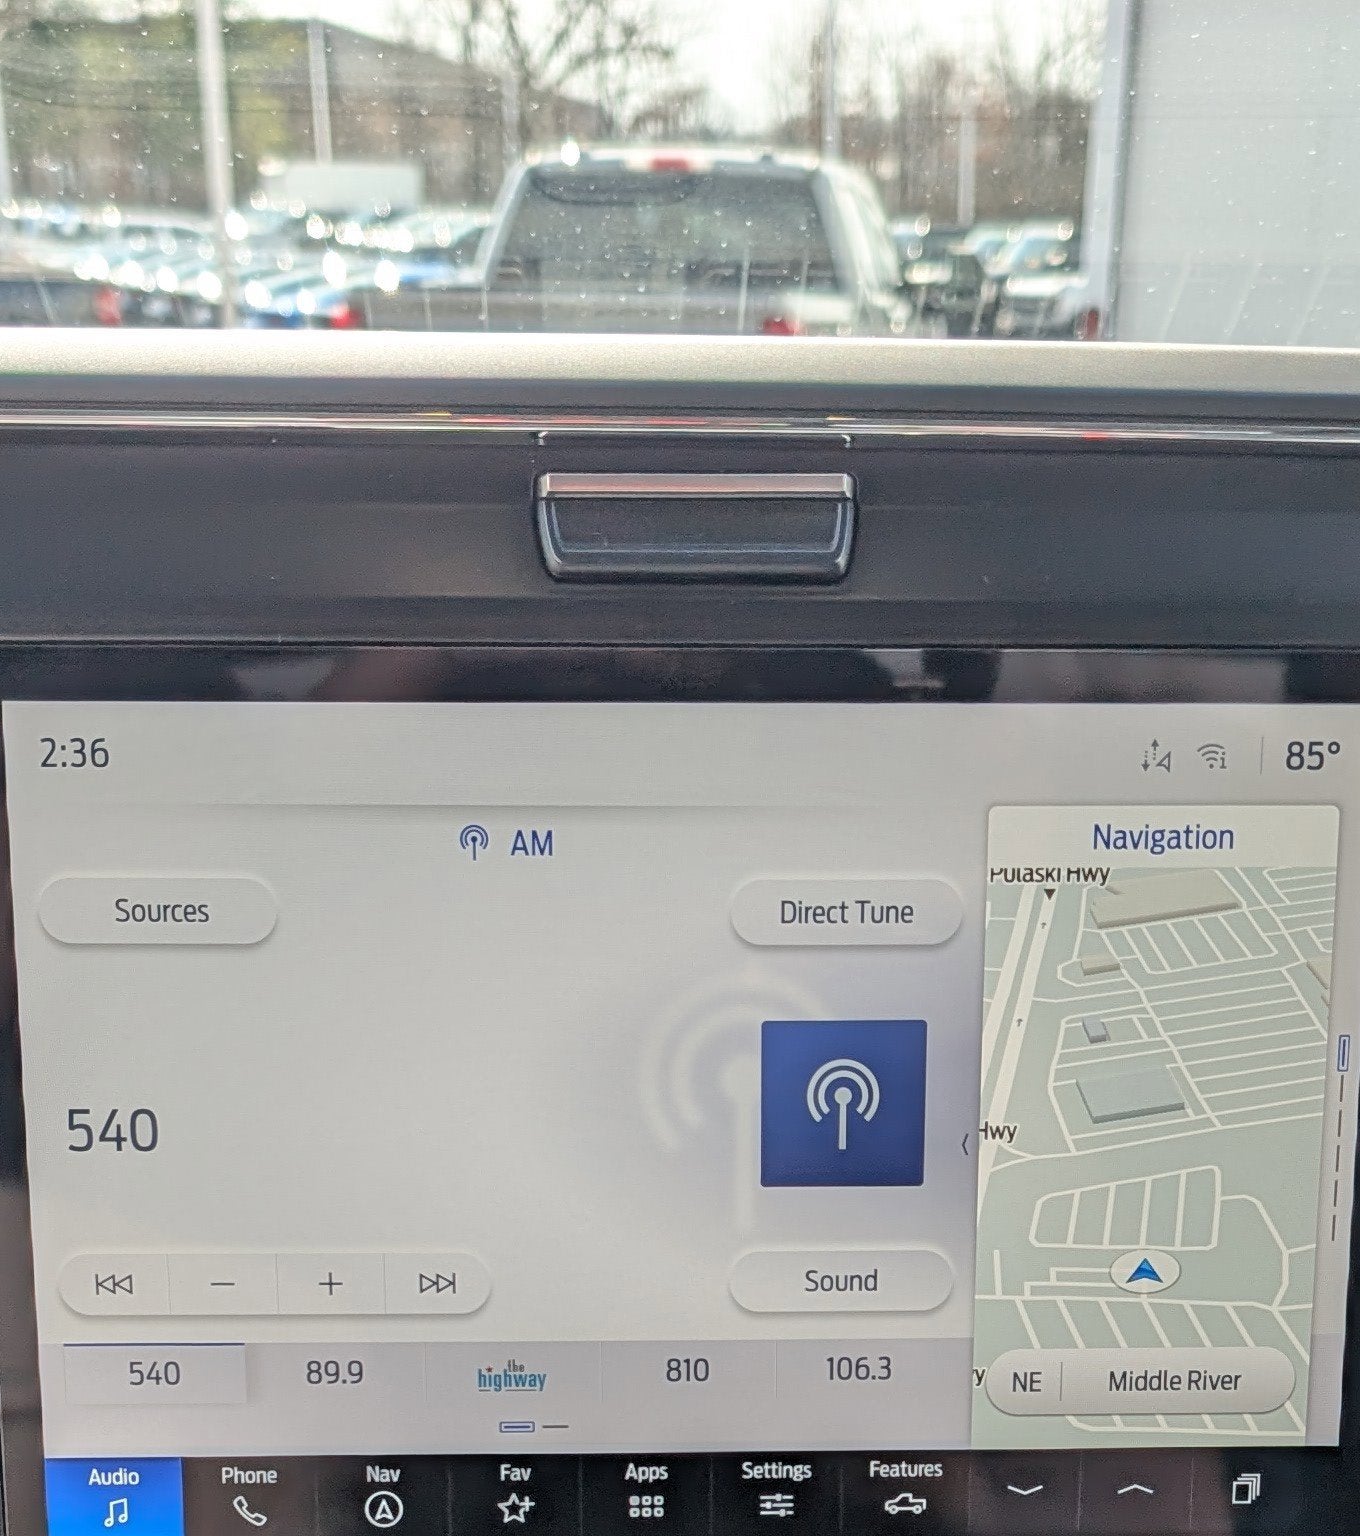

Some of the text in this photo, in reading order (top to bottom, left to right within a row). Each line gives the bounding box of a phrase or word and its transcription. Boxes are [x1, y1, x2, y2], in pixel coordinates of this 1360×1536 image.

[41, 738, 109, 767] 2:36
[1286, 742, 1340, 770] 85°
[511, 830, 552, 855] AM
[1094, 824, 1233, 854] Navigation
[991, 868, 1110, 886] Pulaski Hwy
[115, 899, 209, 922] Sources
[781, 900, 913, 923] Direct Tune
[69, 1109, 157, 1151] 540
[806, 1269, 877, 1291] Sound
[130, 1361, 180, 1385] 540
[307, 1361, 363, 1384] 89.9
[506, 1359, 525, 1372] the
[667, 1358, 709, 1382] 810
[827, 1357, 891, 1380] 106.3
[478, 1368, 546, 1392] highway
[1013, 1372, 1041, 1392] NE
[1110, 1370, 1241, 1391] Middle River
[89, 1468, 139, 1485] Audio
[222, 1467, 277, 1483] Phone
[367, 1466, 400, 1482] Nav
[500, 1464, 531, 1481] Fav
[625, 1463, 668, 1483] Apps
[742, 1462, 812, 1481] Settings
[870, 1461, 943, 1477] Features
